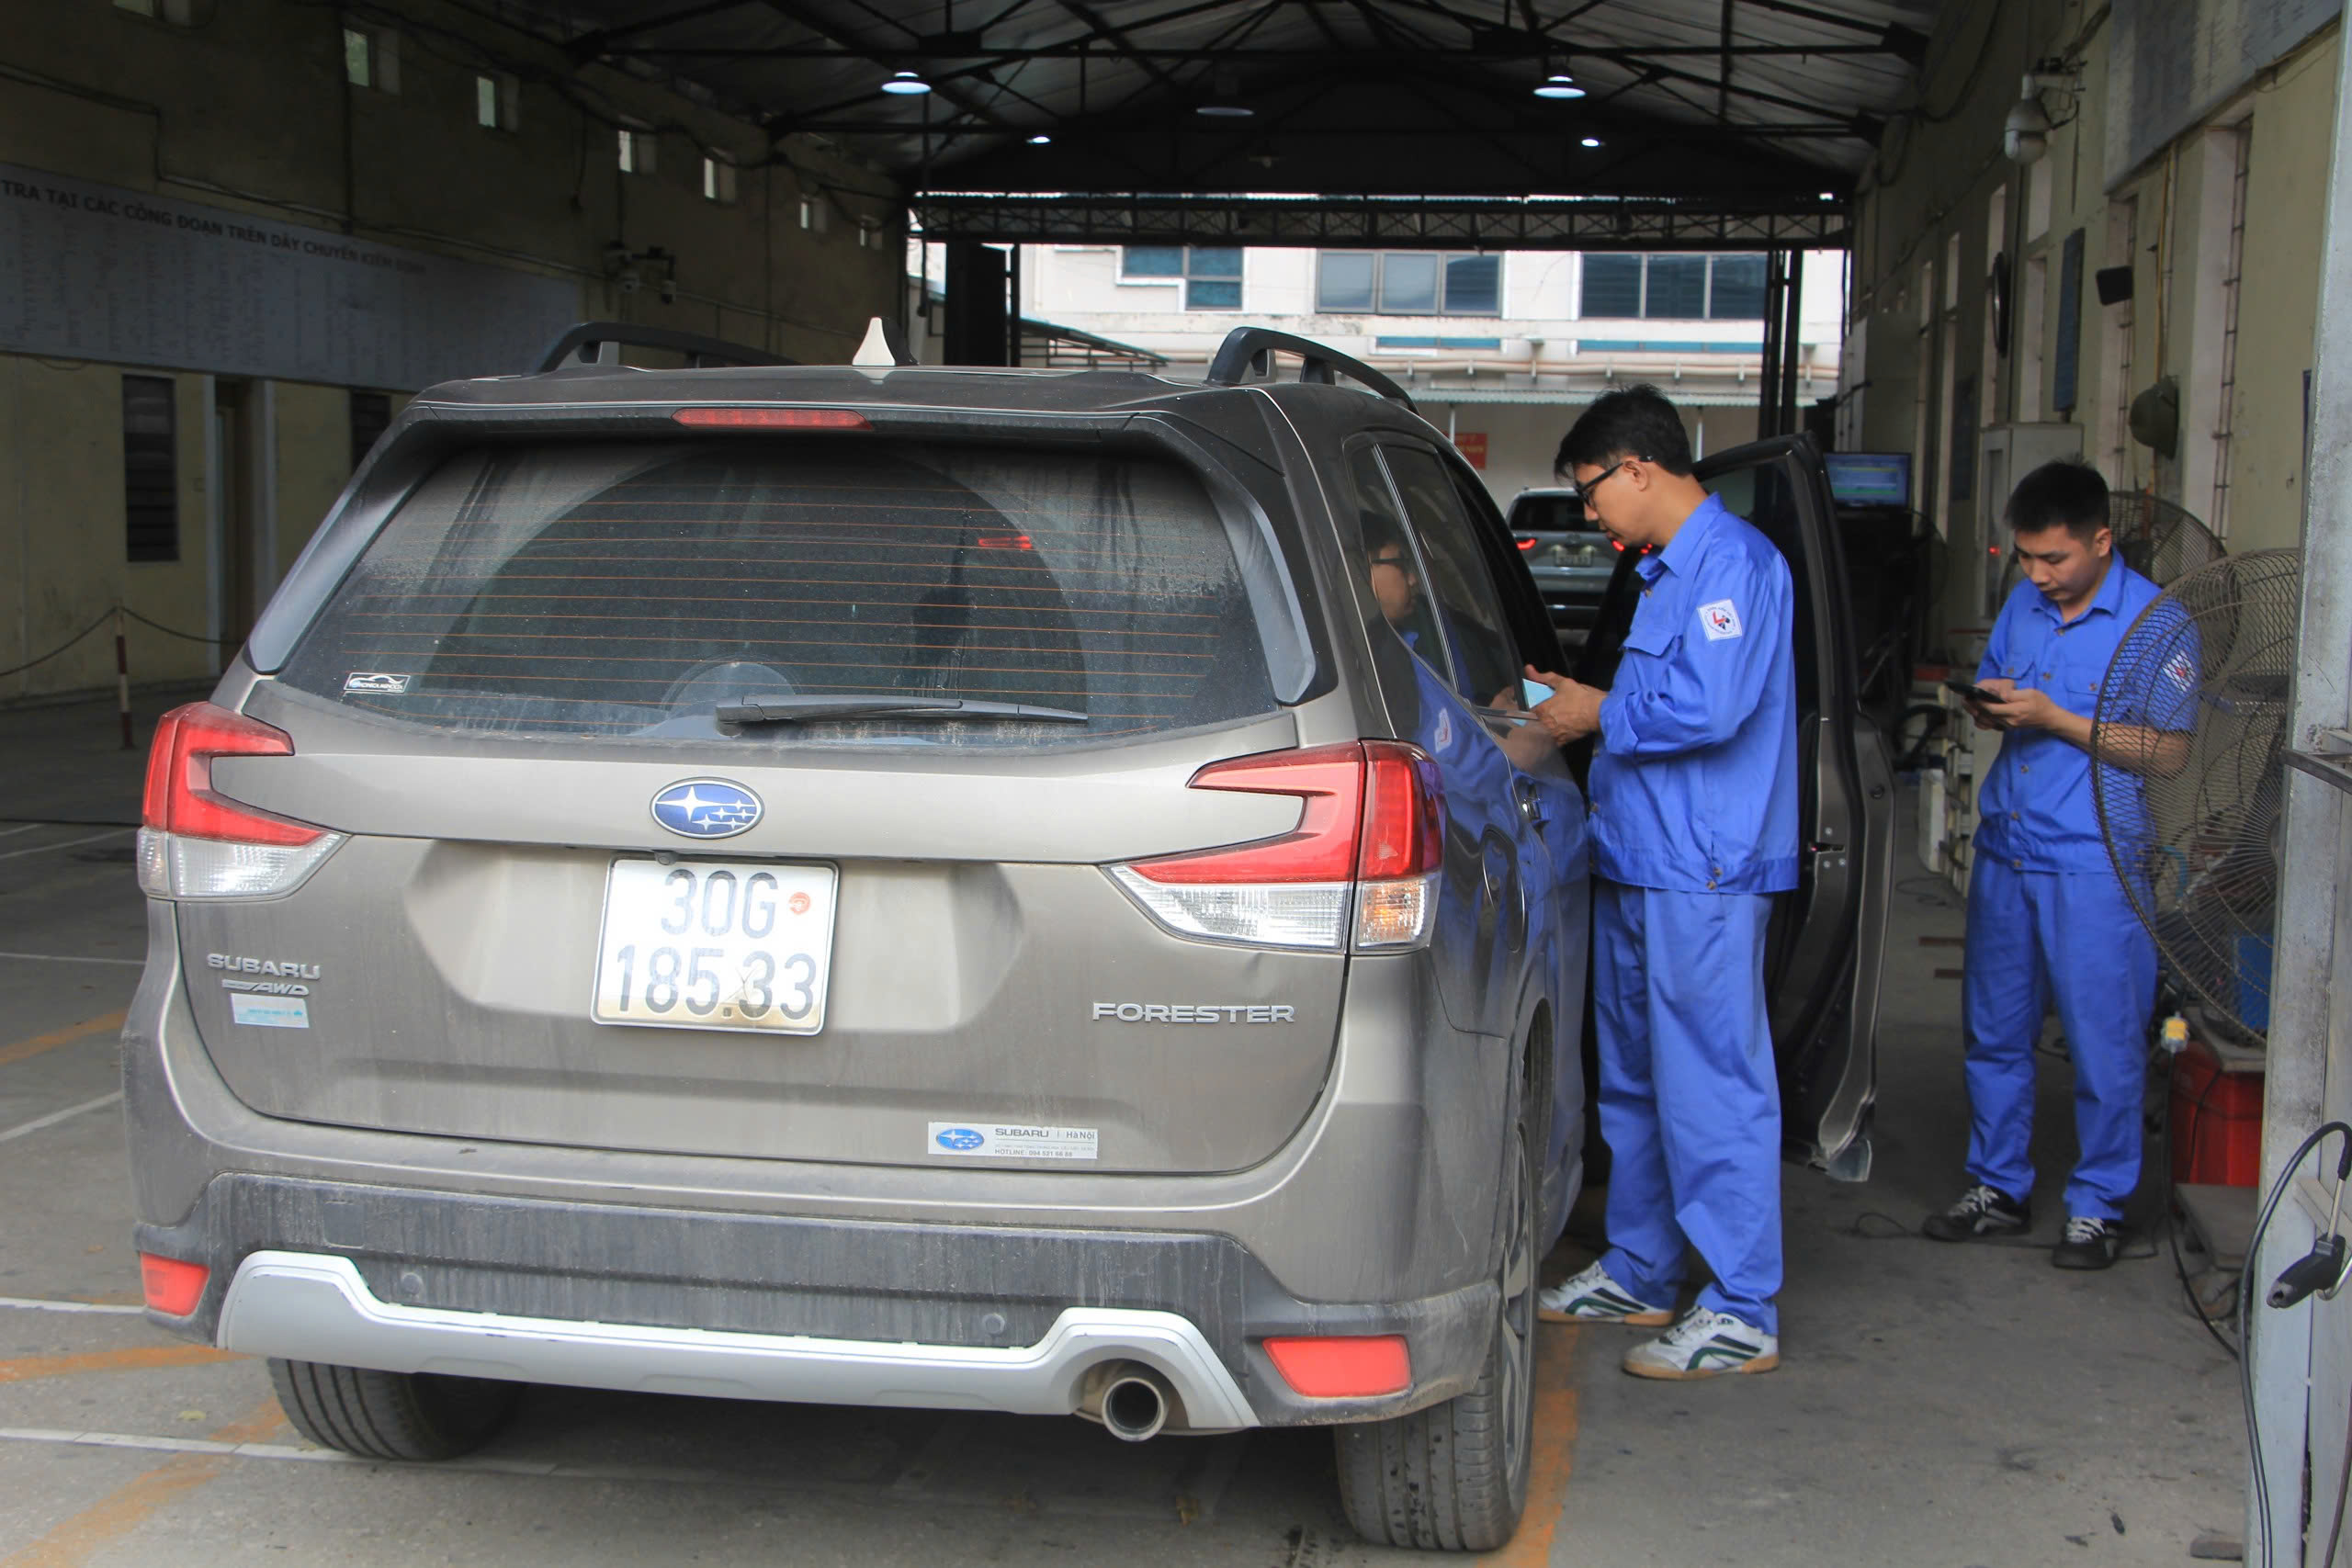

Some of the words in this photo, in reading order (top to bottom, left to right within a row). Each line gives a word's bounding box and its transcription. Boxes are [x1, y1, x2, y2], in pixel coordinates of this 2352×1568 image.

[1, 179, 40, 201] TRA
[46, 188, 78, 210] TẠI
[125, 201, 173, 226] CÔNG
[227, 223, 266, 244] TRÊN
[661, 869, 779, 939] 30G
[207, 953, 321, 980] SUBARU
[617, 944, 817, 1021] 185.33
[1092, 1002, 1295, 1023] FORESTER
[995, 1128, 1049, 1137] SUBARU
